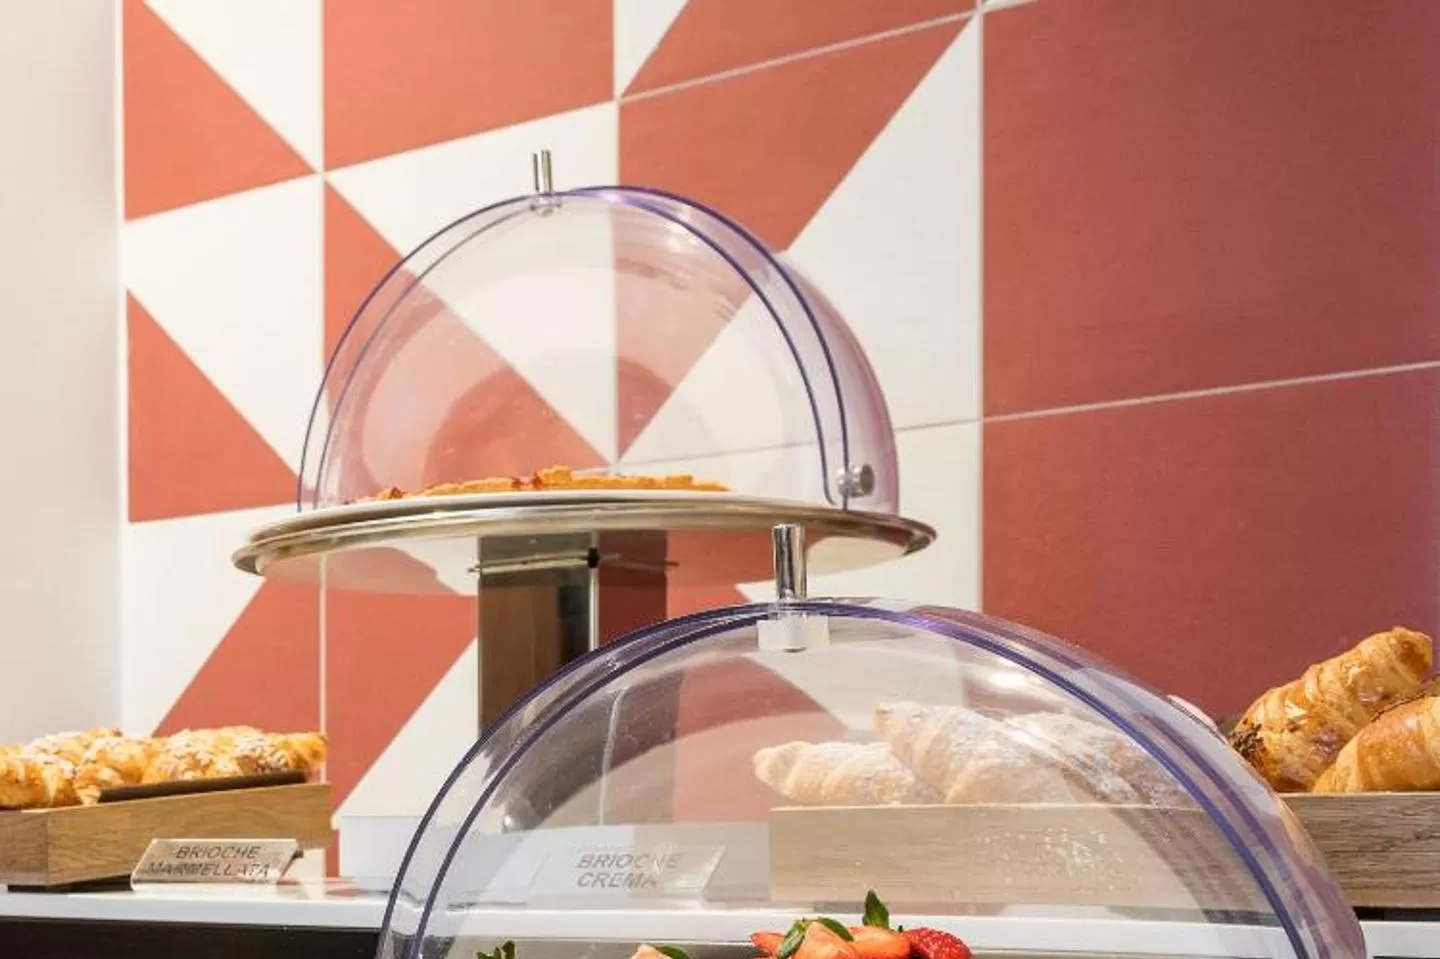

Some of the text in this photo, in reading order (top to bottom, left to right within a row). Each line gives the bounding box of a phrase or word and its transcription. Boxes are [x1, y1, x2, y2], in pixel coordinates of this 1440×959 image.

[175, 845, 262, 860] BRIOCHE
[575, 851, 684, 870] BRIOCHE
[576, 871, 660, 888] CREMA
